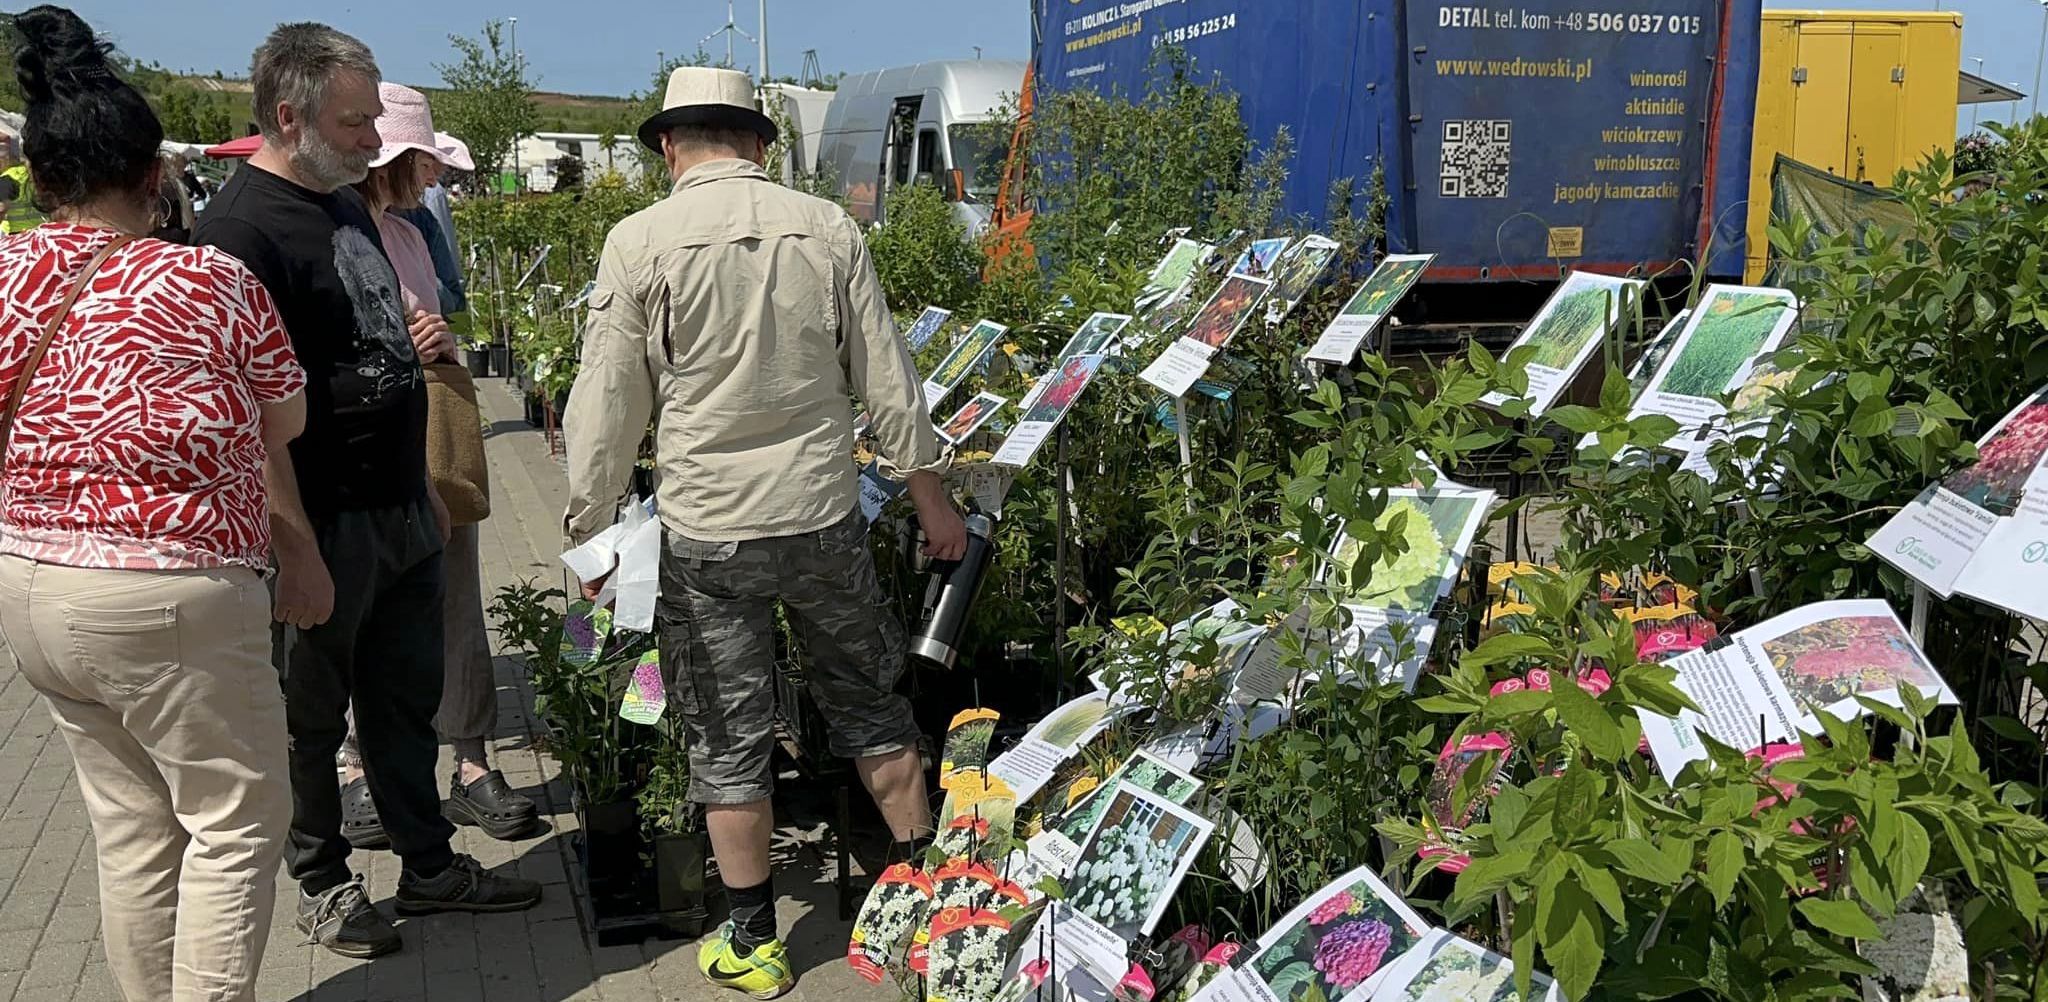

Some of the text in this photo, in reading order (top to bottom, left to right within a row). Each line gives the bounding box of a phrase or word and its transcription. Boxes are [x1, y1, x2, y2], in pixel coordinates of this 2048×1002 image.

[1082, 7, 1114, 30] KOLINCZ
[1173, 27, 1185, 43] 58
[1187, 23, 1200, 40] 56
[1201, 17, 1220, 36] 225
[1222, 13, 1236, 30] 24
[1439, 7, 1700, 34] DETAL tel. kom +48 506 037 015
[1065, 17, 1142, 54] www.wedrowski.pl
[1436, 57, 1592, 82] www.wedrowski.pl
[1630, 70, 1687, 87] winorośl
[1625, 98, 1685, 115] aktinidie
[1602, 126, 1683, 147] wiciokrzewy
[1594, 154, 1681, 171] winobluszcze
[1553, 181, 1680, 204] jagody kamczackie
[1240, 964, 1258, 987] ortensja
